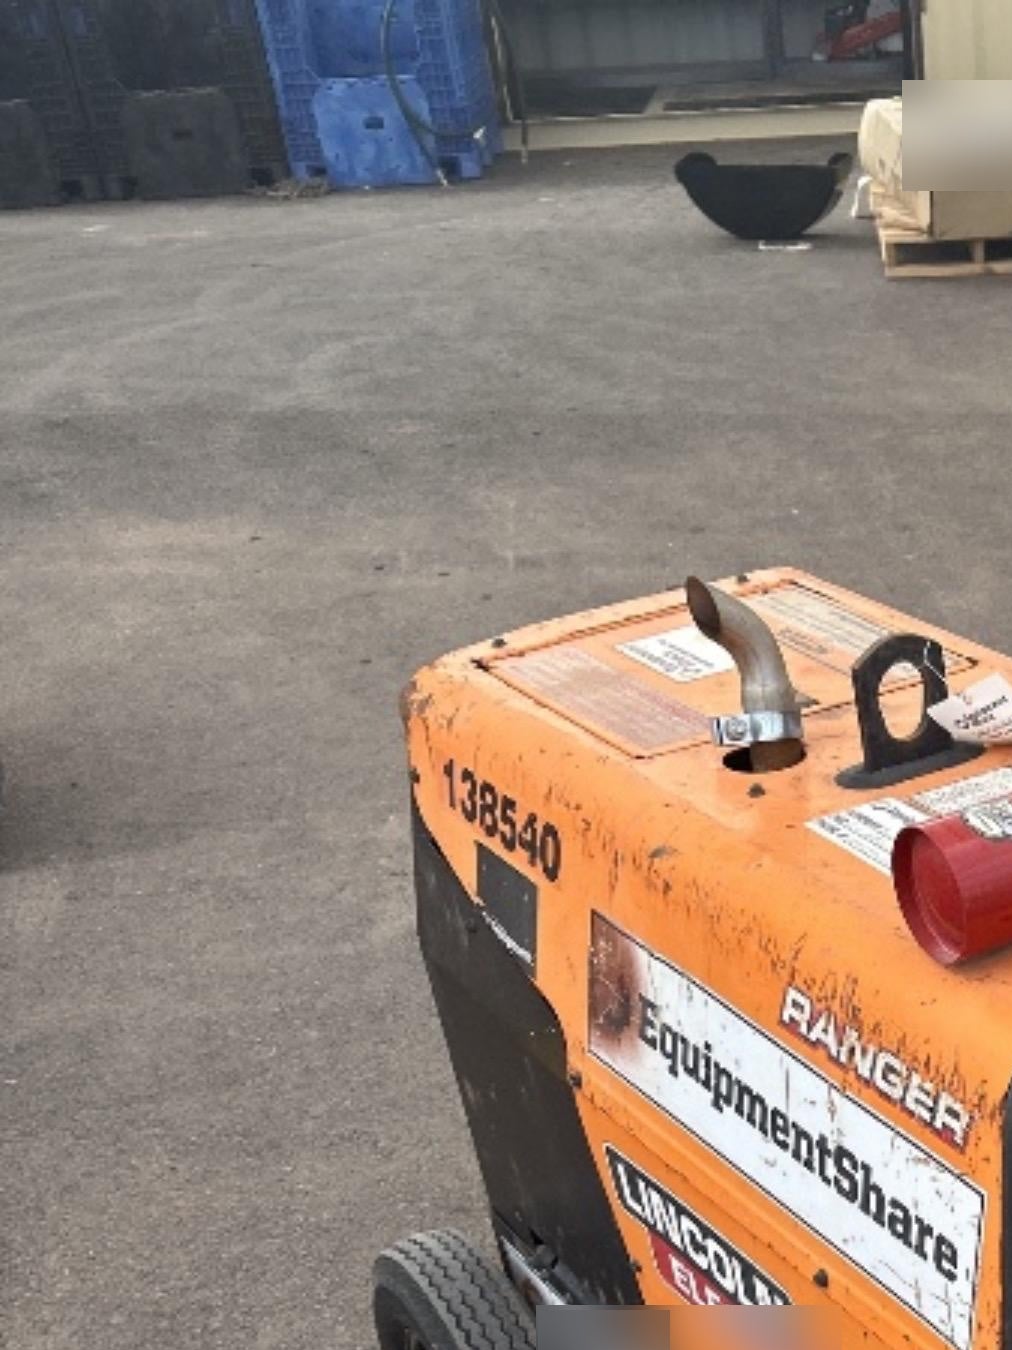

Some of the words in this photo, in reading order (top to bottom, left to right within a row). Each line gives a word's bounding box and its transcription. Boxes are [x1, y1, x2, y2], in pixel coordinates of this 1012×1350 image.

[442, 758, 562, 882] 138540
[637, 992, 960, 1284] EquipmentShare
[779, 986, 974, 1151] RANGER
